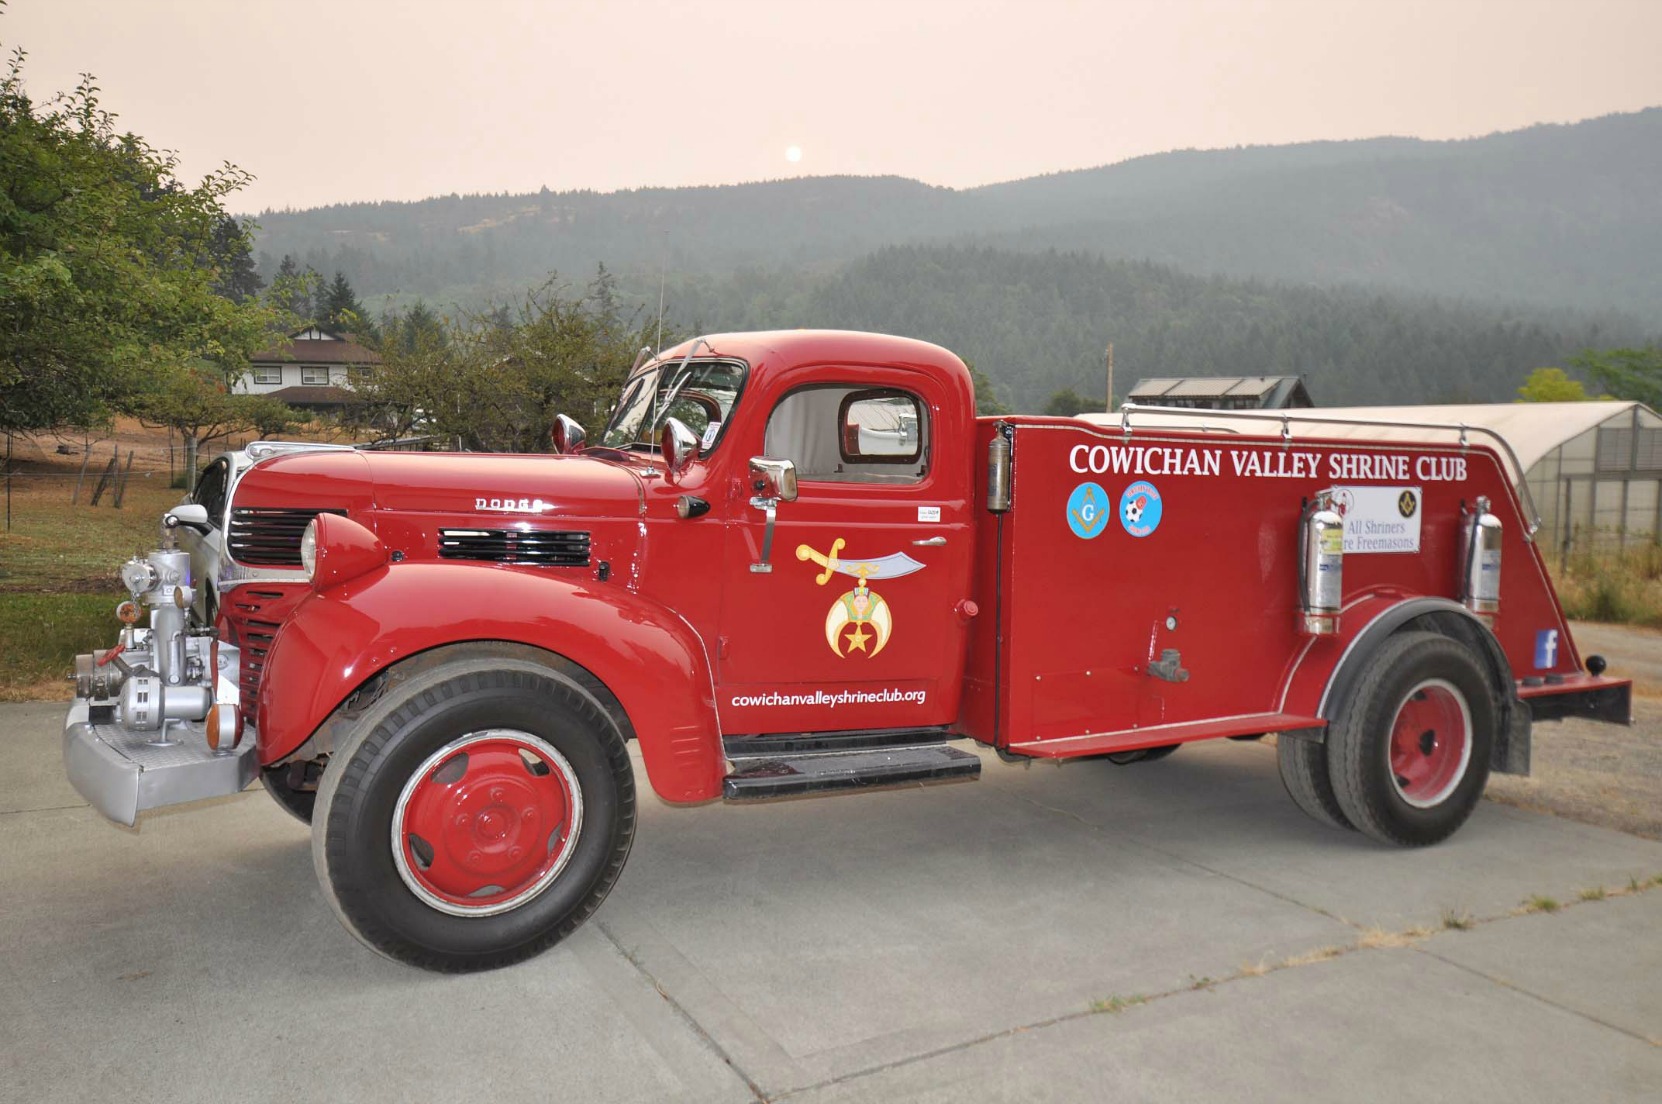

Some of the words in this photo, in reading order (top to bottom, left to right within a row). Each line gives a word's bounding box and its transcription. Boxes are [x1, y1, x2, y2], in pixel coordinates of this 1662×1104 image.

[1069, 444, 1222, 476] COWICHAN
[1230, 450, 1322, 478] VALLEY
[1329, 453, 1410, 480] SHRINE
[1415, 456, 1467, 481] CLUB
[1082, 504, 1095, 521] G
[1347, 520, 1362, 535] All
[1365, 520, 1406, 535] Shriners
[1344, 540, 1354, 550] re
[1357, 537, 1415, 550] Freemasons
[731, 688, 926, 708] cowichanvalleyshrineclub.org
